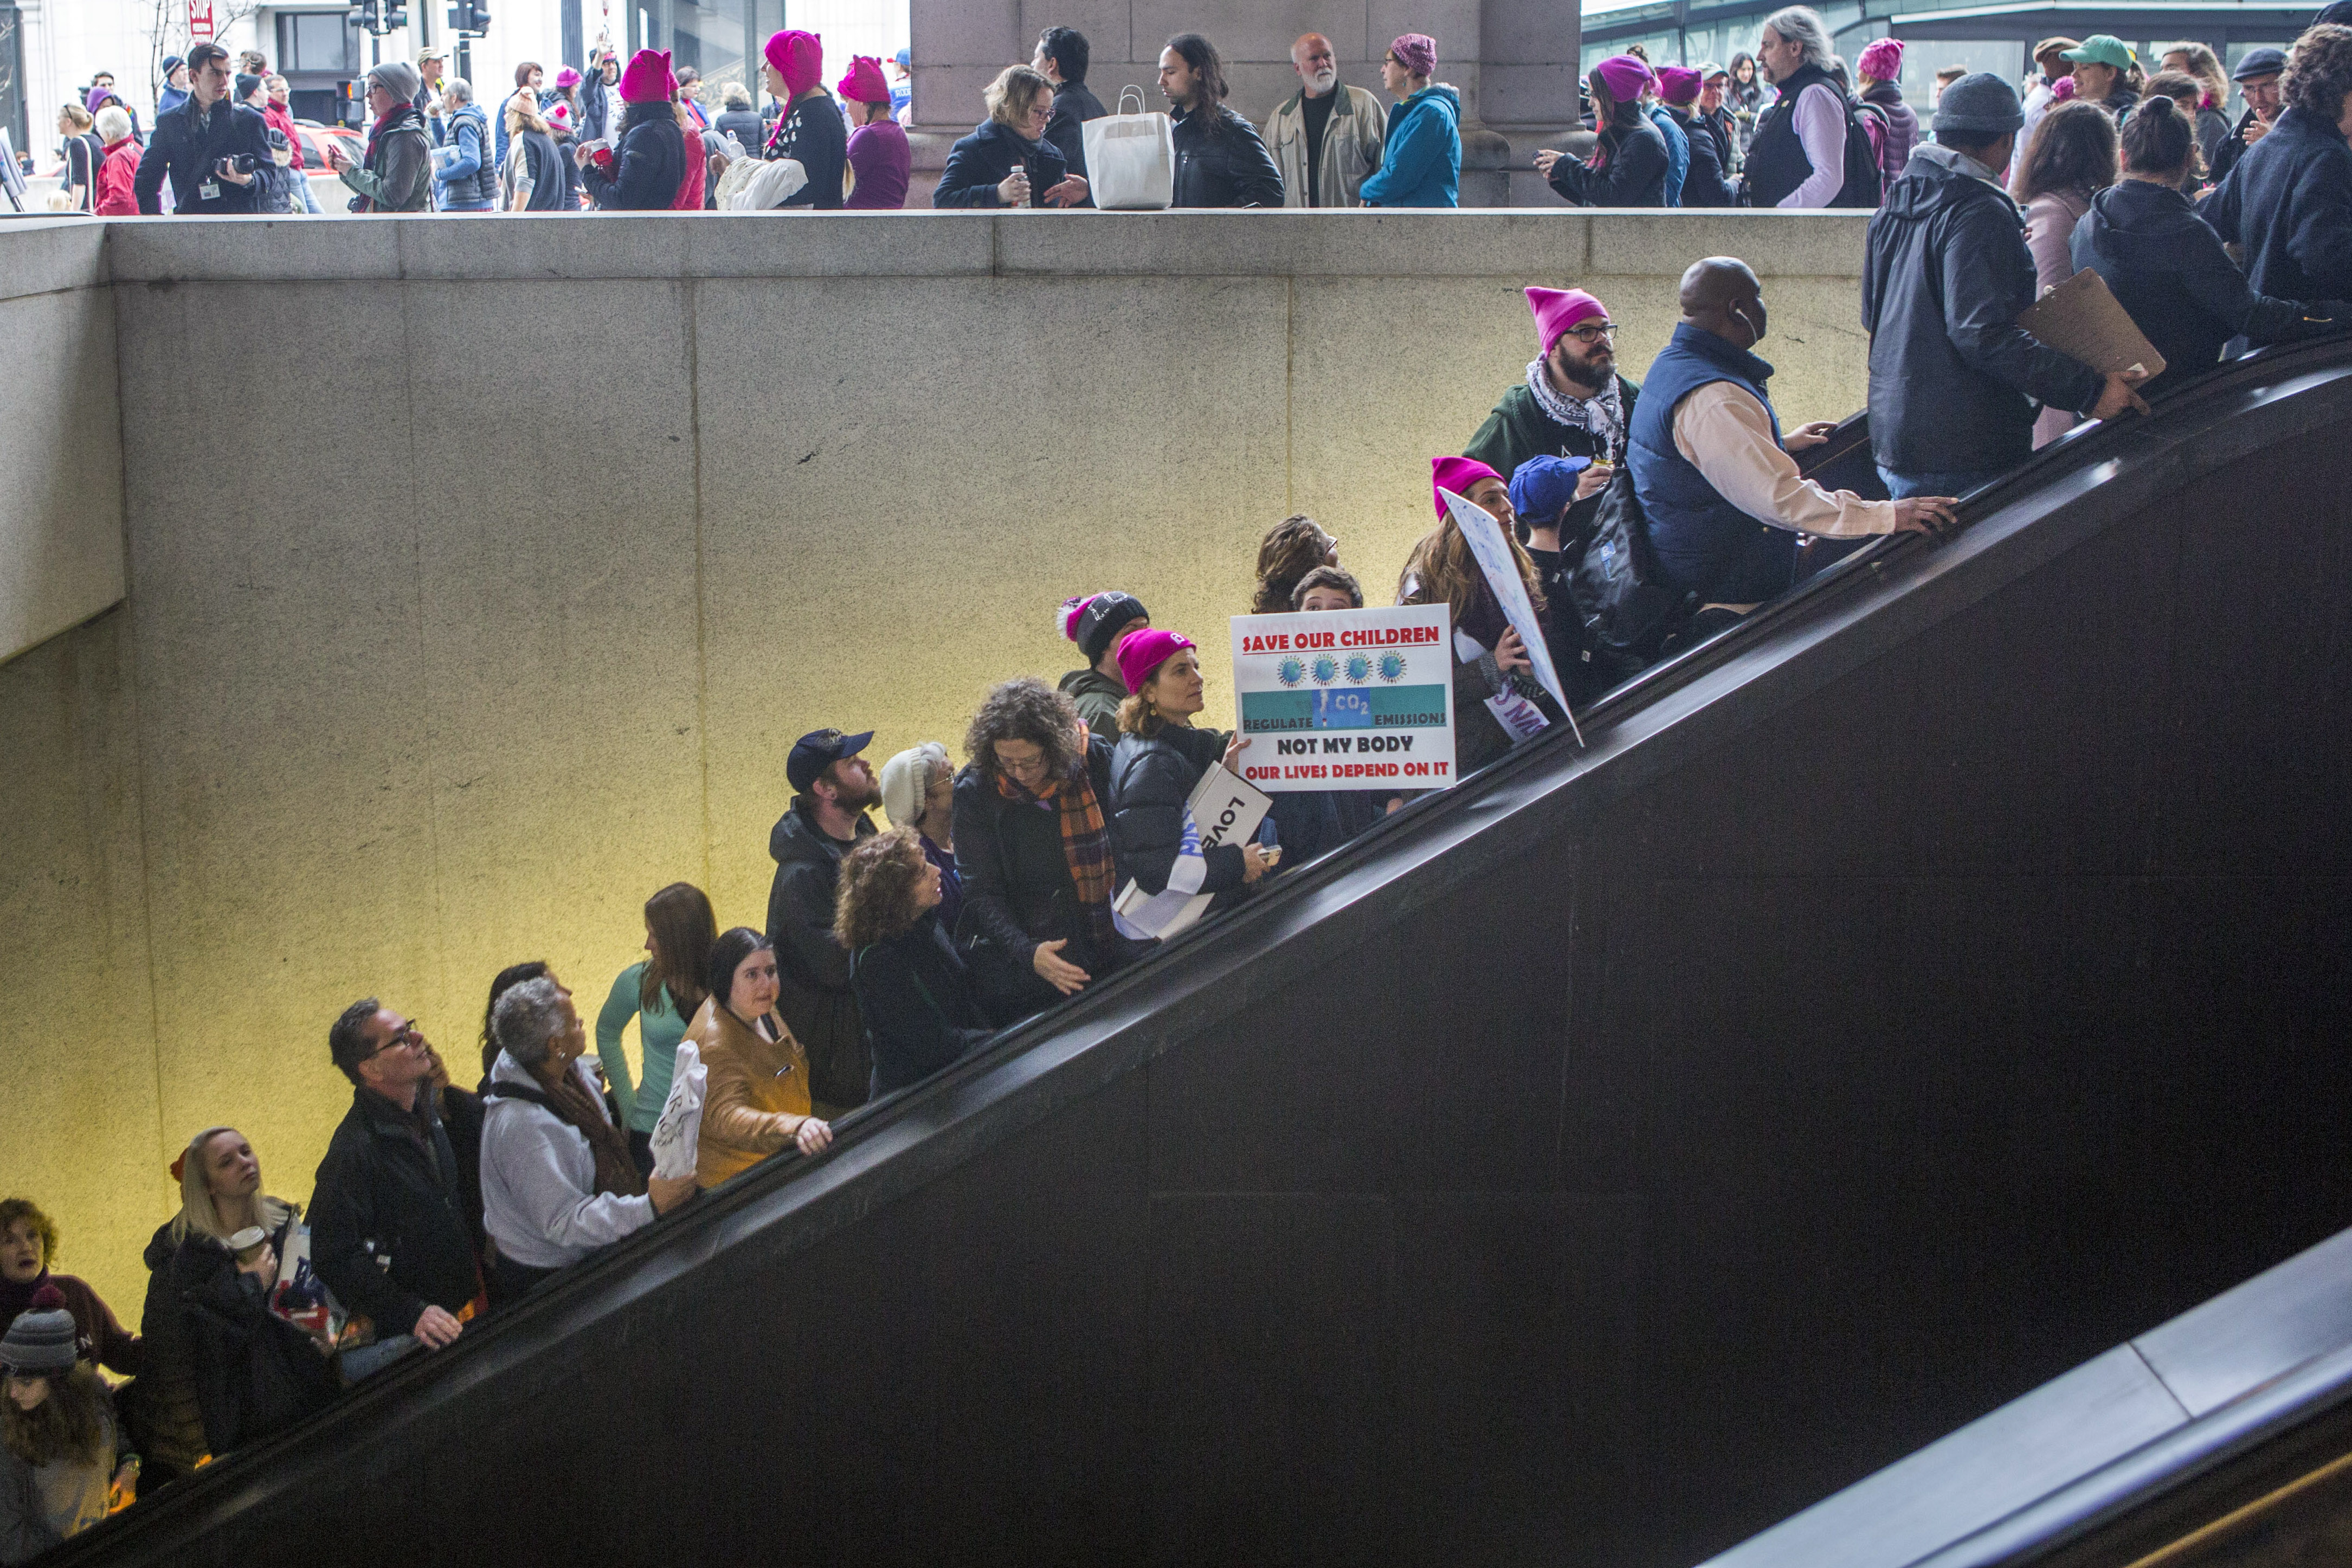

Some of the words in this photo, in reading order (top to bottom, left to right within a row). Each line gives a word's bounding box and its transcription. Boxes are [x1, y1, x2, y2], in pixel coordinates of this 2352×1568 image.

[190, 0, 210, 19] STOP
[1242, 635, 1290, 653] SAVE
[1294, 632, 1336, 649] OUR
[1341, 626, 1439, 647] CHILDREN
[1243, 717, 1313, 730] REGULATE
[1374, 712, 1446, 725] EMISSIONS
[1277, 738, 1318, 755] NOT
[1323, 737, 1352, 753] MY
[1357, 735, 1413, 753] BODY
[1245, 766, 1280, 780] OUR
[1284, 764, 1328, 779] LIVES
[1332, 763, 1399, 778] DEPEND
[1403, 762, 1429, 776] ON
[1434, 762, 1448, 776] IT
[1201, 796, 1246, 848] LOVE
